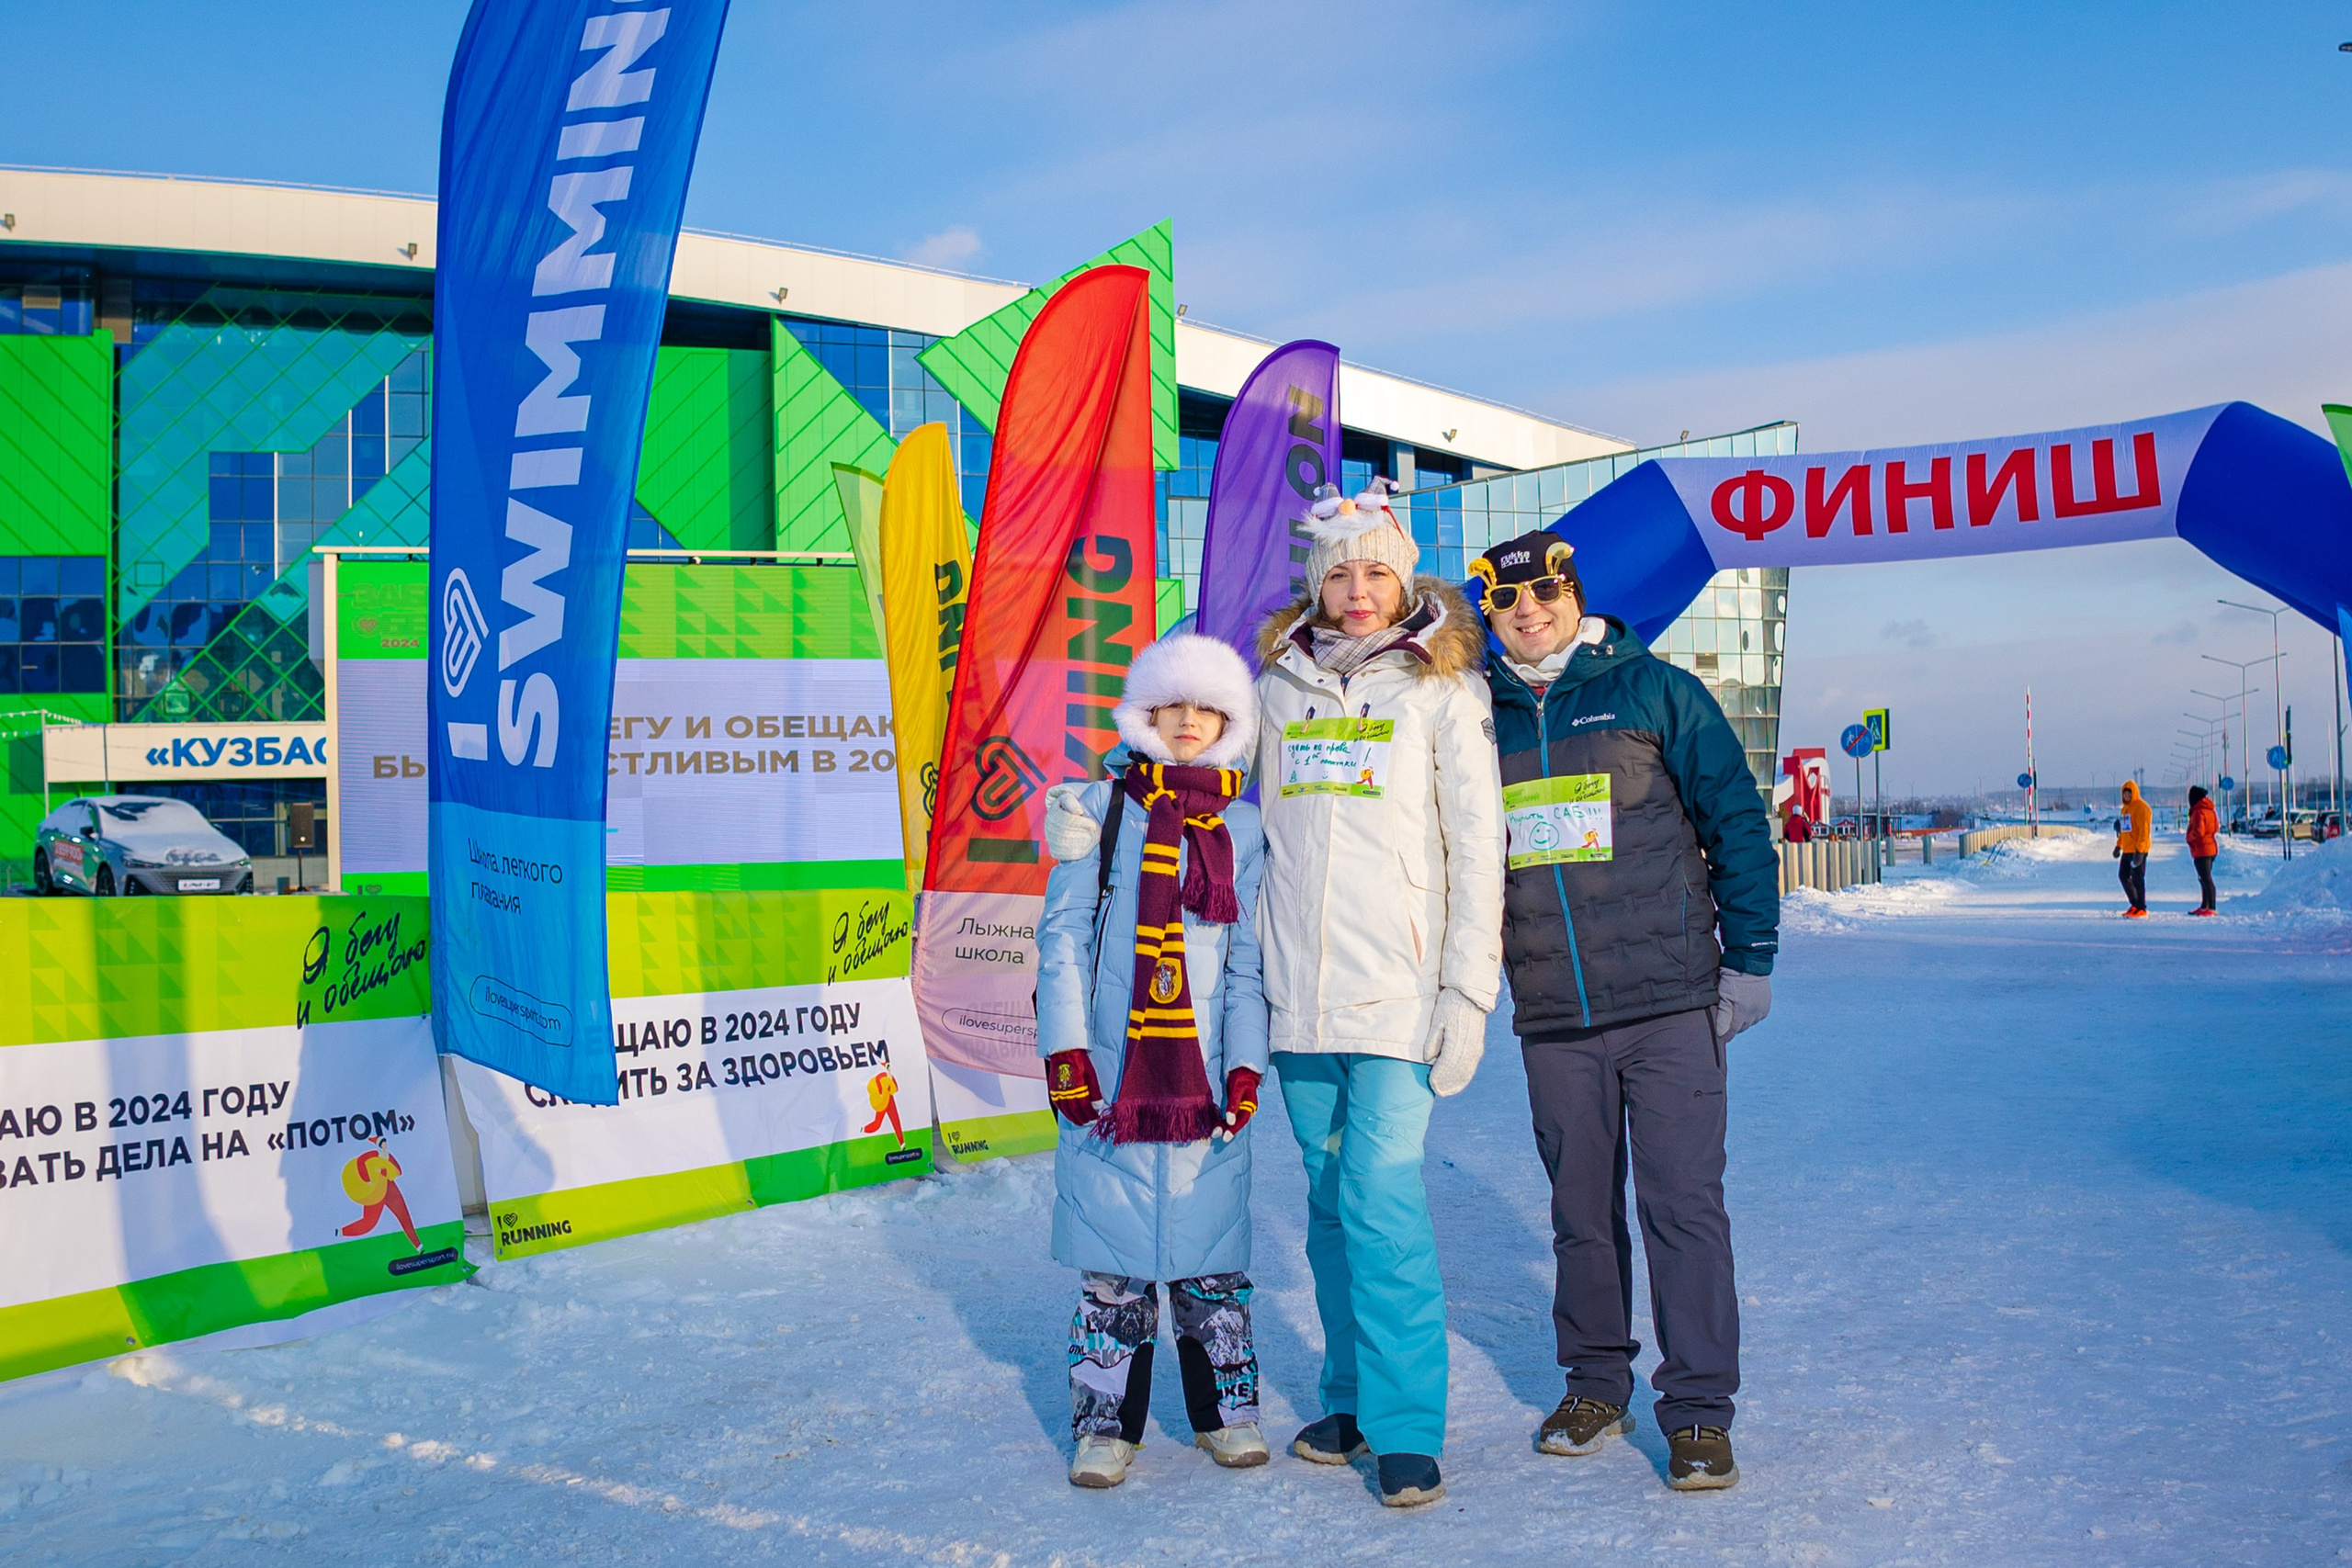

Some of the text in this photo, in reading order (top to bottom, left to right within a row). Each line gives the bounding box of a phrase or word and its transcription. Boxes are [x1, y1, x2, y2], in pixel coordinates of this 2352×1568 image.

[498, 0, 672, 770] SWIMMIN
[1710, 431, 2163, 542] ФИНИШ
[380, 638, 419, 649] 2024
[685, 716, 711, 739] И
[1579, 713, 1616, 725] Columbia
[145, 737, 327, 767] «КУЗБАС
[812, 750, 837, 773] В
[848, 749, 897, 773] 20
[502, 856, 563, 884] легкого
[956, 918, 1035, 940] Лыжна
[955, 946, 1024, 964] школа
[701, 1015, 718, 1045] В
[725, 1009, 790, 1043] 2024
[796, 1002, 861, 1036] ГОДУ
[676, 1060, 718, 1093] ЗА
[721, 1039, 891, 1089] ЗДОРОВЬЕМ
[74, 1100, 97, 1133] В
[108, 1090, 193, 1129] 2024
[202, 1080, 290, 1118] ГОДУ
[96, 1135, 193, 1182] ДЕЛА
[201, 1129, 250, 1162] НА
[267, 1109, 416, 1151] «ПОТОМ»
[951, 1139, 989, 1156] RUNNING
[501, 1220, 572, 1247] RUNNING
